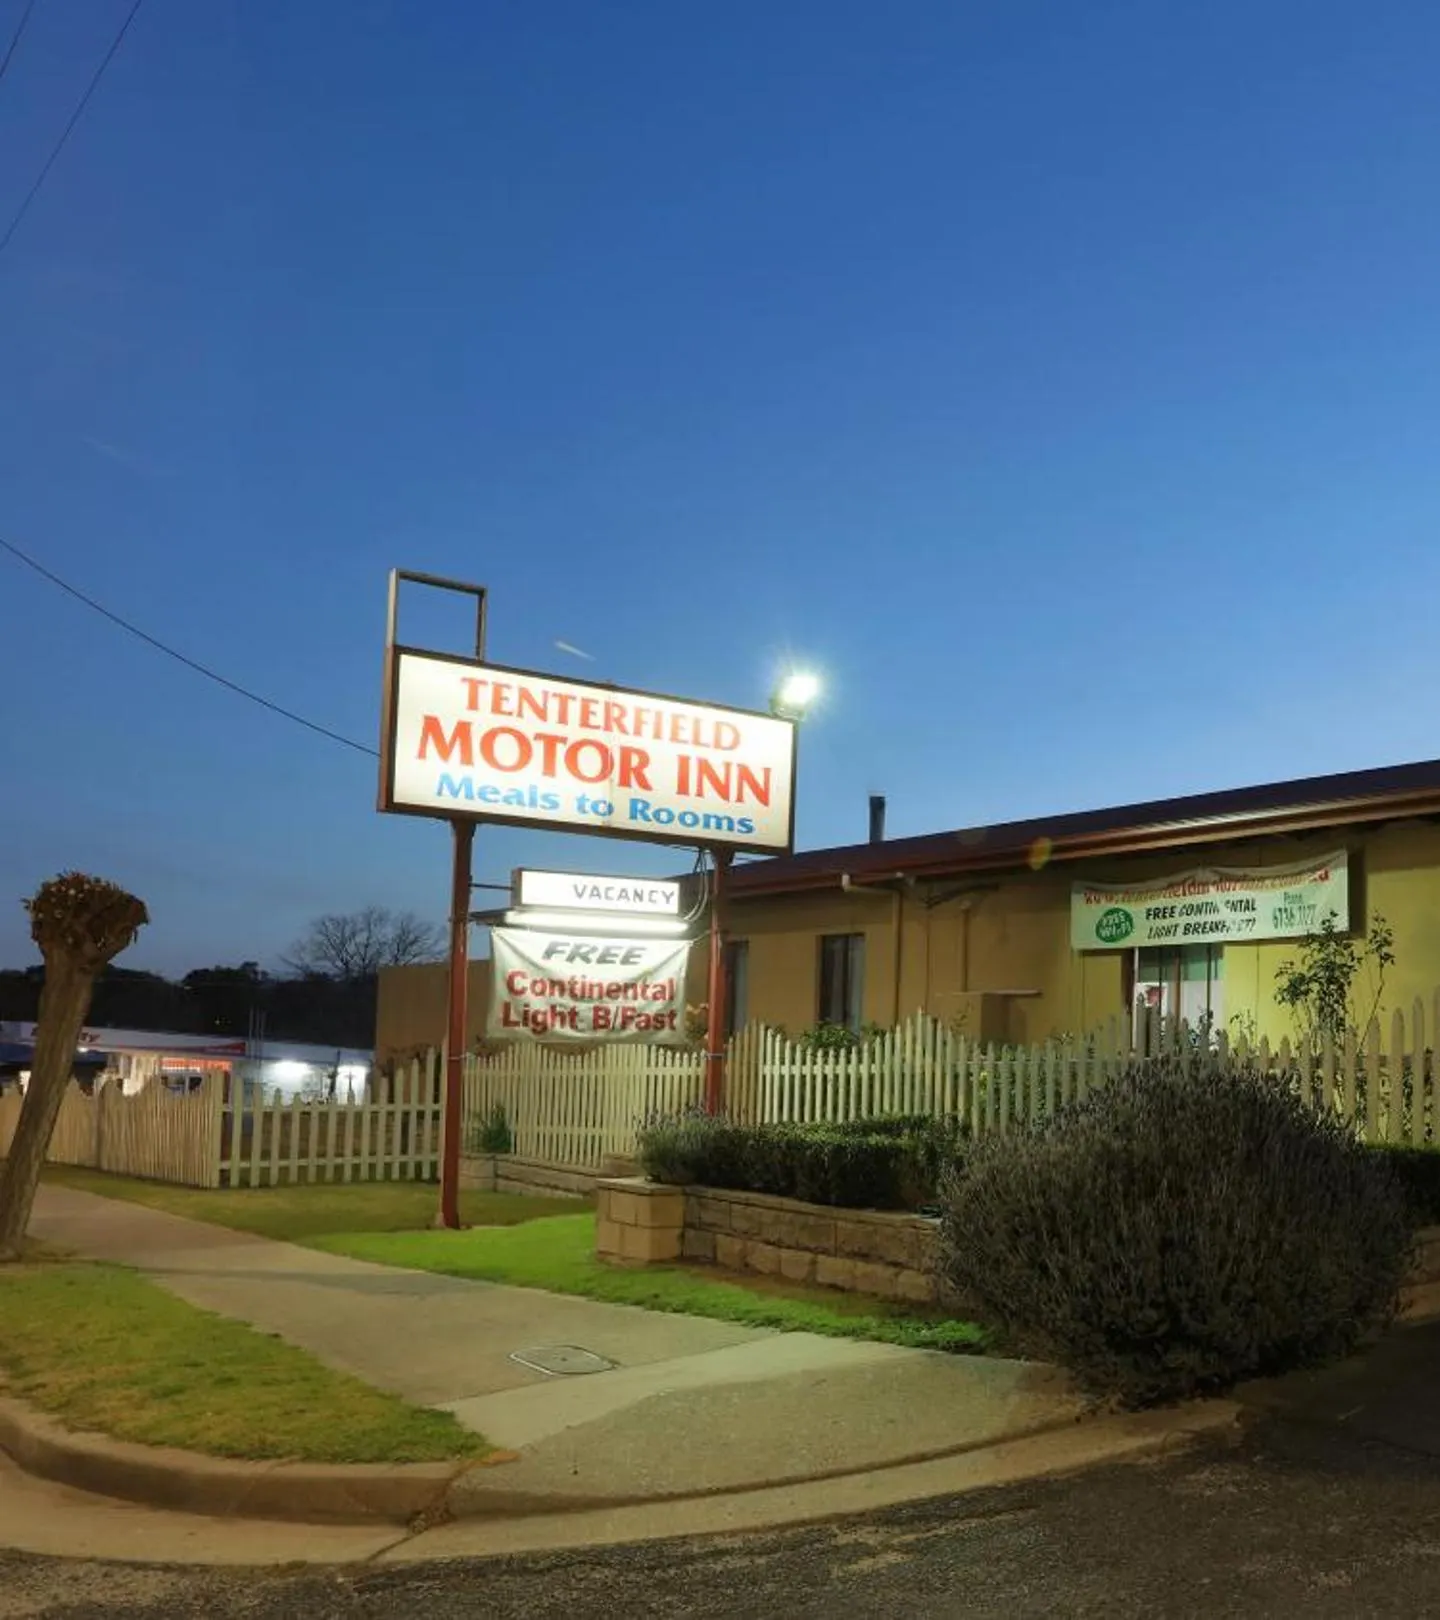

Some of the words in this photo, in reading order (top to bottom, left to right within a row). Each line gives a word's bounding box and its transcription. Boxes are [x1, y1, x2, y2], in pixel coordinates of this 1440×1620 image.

[461, 677, 741, 750] TENTERFIELD
[417, 714, 653, 791] MOTOR
[676, 753, 771, 807] INN
[436, 772, 560, 811] Meals
[576, 791, 614, 817] to
[628, 797, 756, 834] Rooms
[572, 883, 675, 905] VACANCY
[1145, 905, 1177, 920] FREE
[541, 941, 647, 966] FREE
[506, 970, 675, 1002] Continental
[502, 1001, 579, 1035] Light
[592, 1005, 679, 1032] B/Fast
